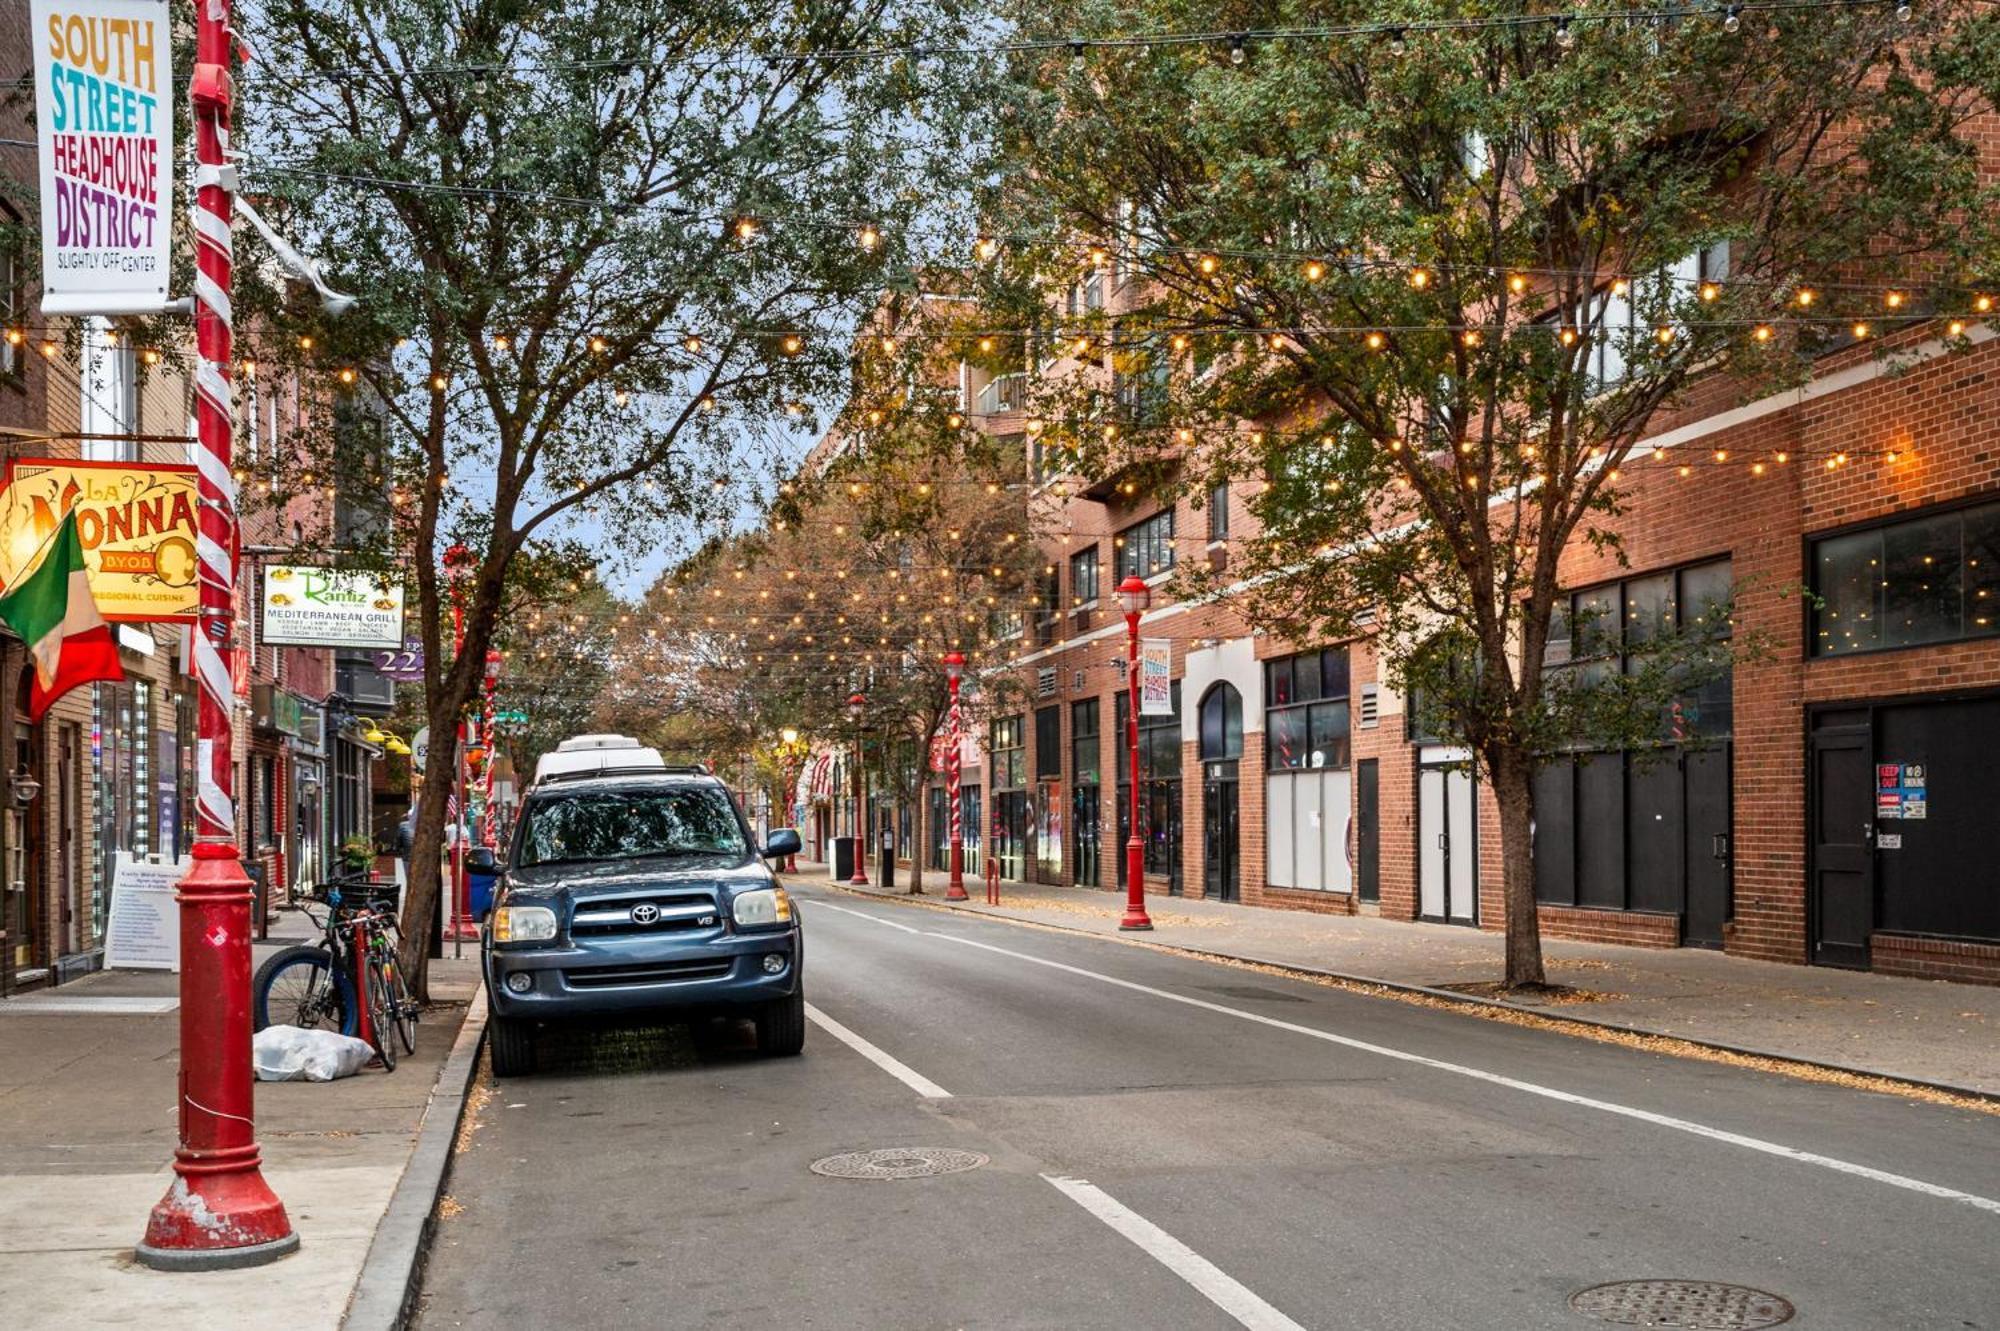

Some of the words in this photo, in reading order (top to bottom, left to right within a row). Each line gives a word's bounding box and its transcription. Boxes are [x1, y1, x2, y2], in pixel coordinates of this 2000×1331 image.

[48, 14, 156, 93] SOUTH
[51, 62, 157, 134] STREET
[53, 133, 157, 204] HEADHOUSE
[55, 176, 156, 249] DISTRICT
[57, 252, 99, 269] SLIGHTLY
[103, 252, 120, 269] OFF
[122, 256, 155, 272] CENTER
[29, 473, 197, 551] NONNA
[146, 593, 184, 602] CUISINE
[267, 609, 362, 621] MEDITERRANEAN
[366, 614, 396, 623] GRILL
[1145, 649, 1168, 666] SOUTH
[1145, 659, 1168, 675] STREET
[1145, 685, 1168, 701] DISTRICT
[1880, 766, 1899, 777] KEEP
[1881, 777, 1898, 788] OUT
[697, 917, 713, 925] V8
